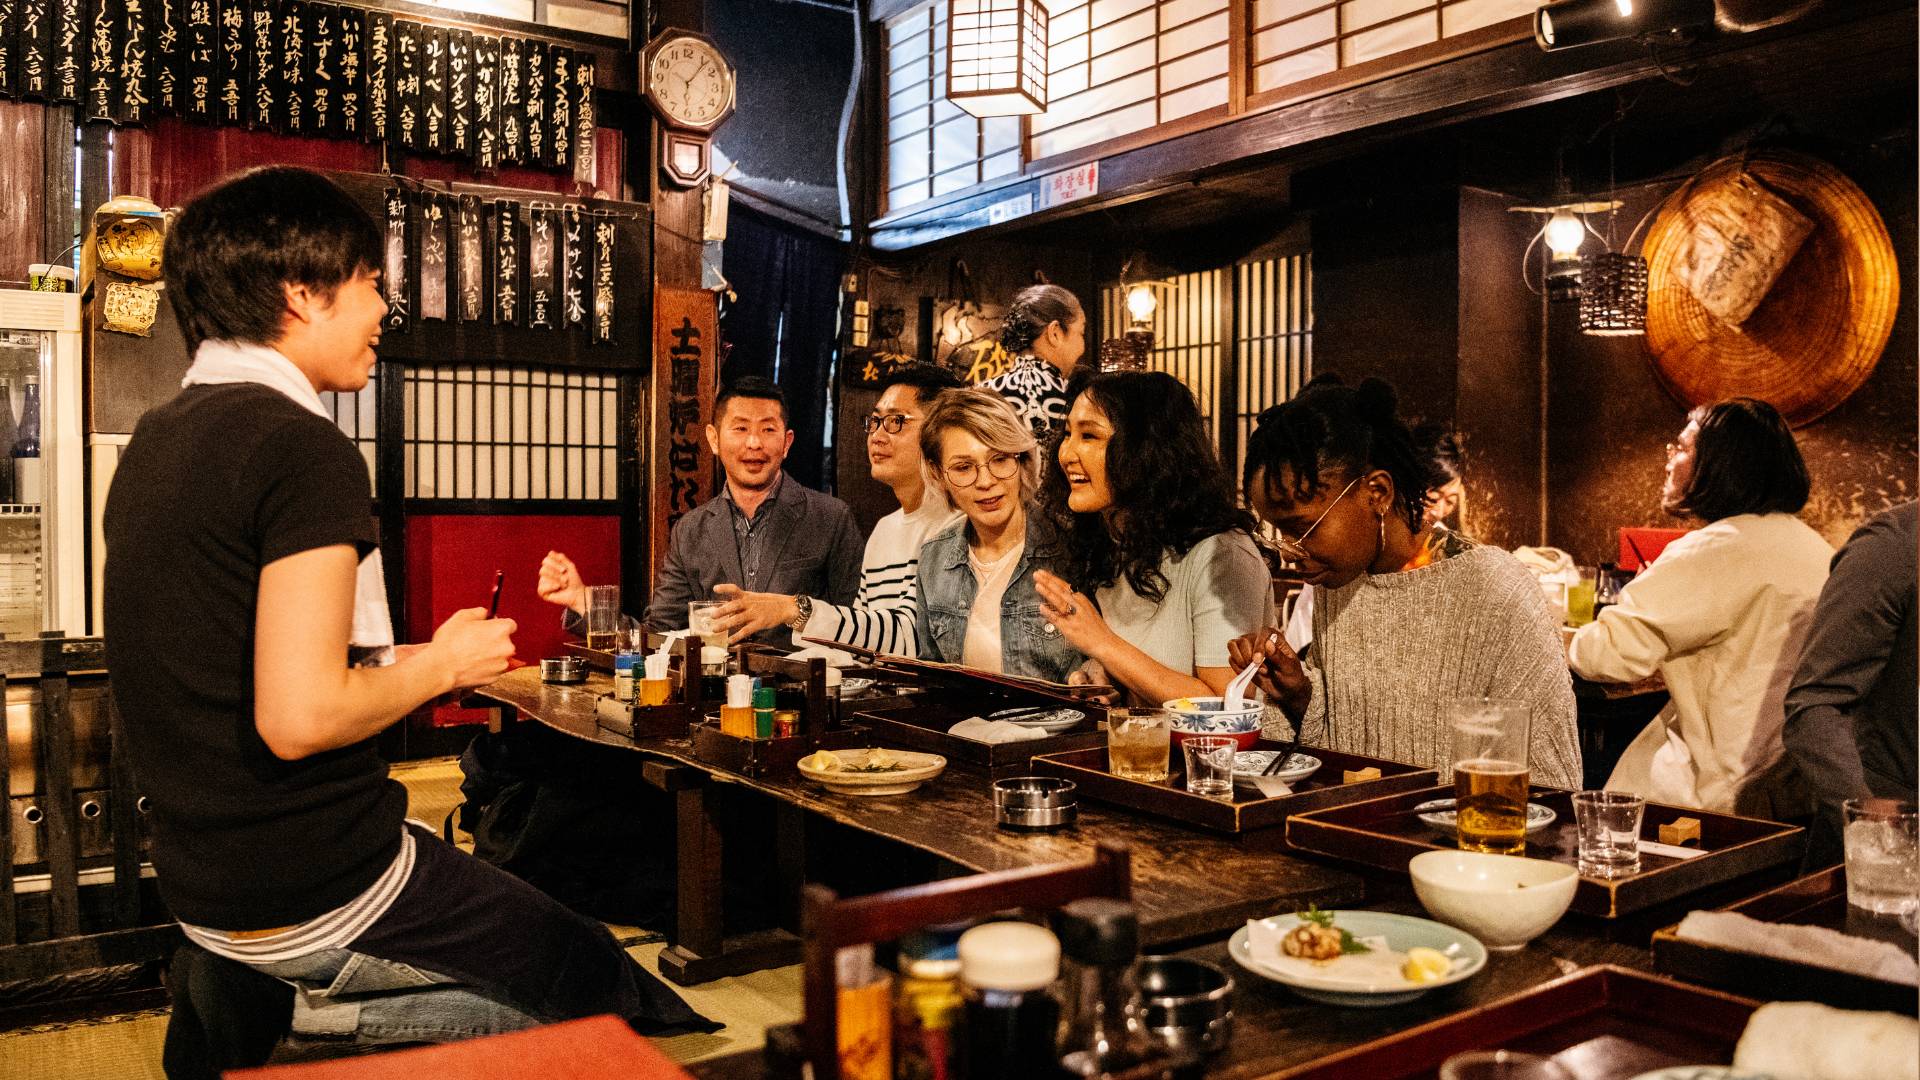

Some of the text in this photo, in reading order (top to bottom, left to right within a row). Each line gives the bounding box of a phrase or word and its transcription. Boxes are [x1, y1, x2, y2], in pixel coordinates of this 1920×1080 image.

[312, 16, 333, 81] もずく
[683, 48, 694, 58] 12
[671, 50, 679, 60] 11
[424, 39, 444, 92] ルイベ
[659, 58, 670, 70] 10
[656, 73, 664, 83] 9
[707, 68, 716, 78] 2
[711, 82, 719, 94] 3
[660, 88, 668, 100] 8
[669, 101, 678, 112] 7
[707, 97, 715, 108] 4
[684, 107, 692, 118] 6
[697, 106, 705, 117] 5
[1054, 168, 1086, 192] 화장실
